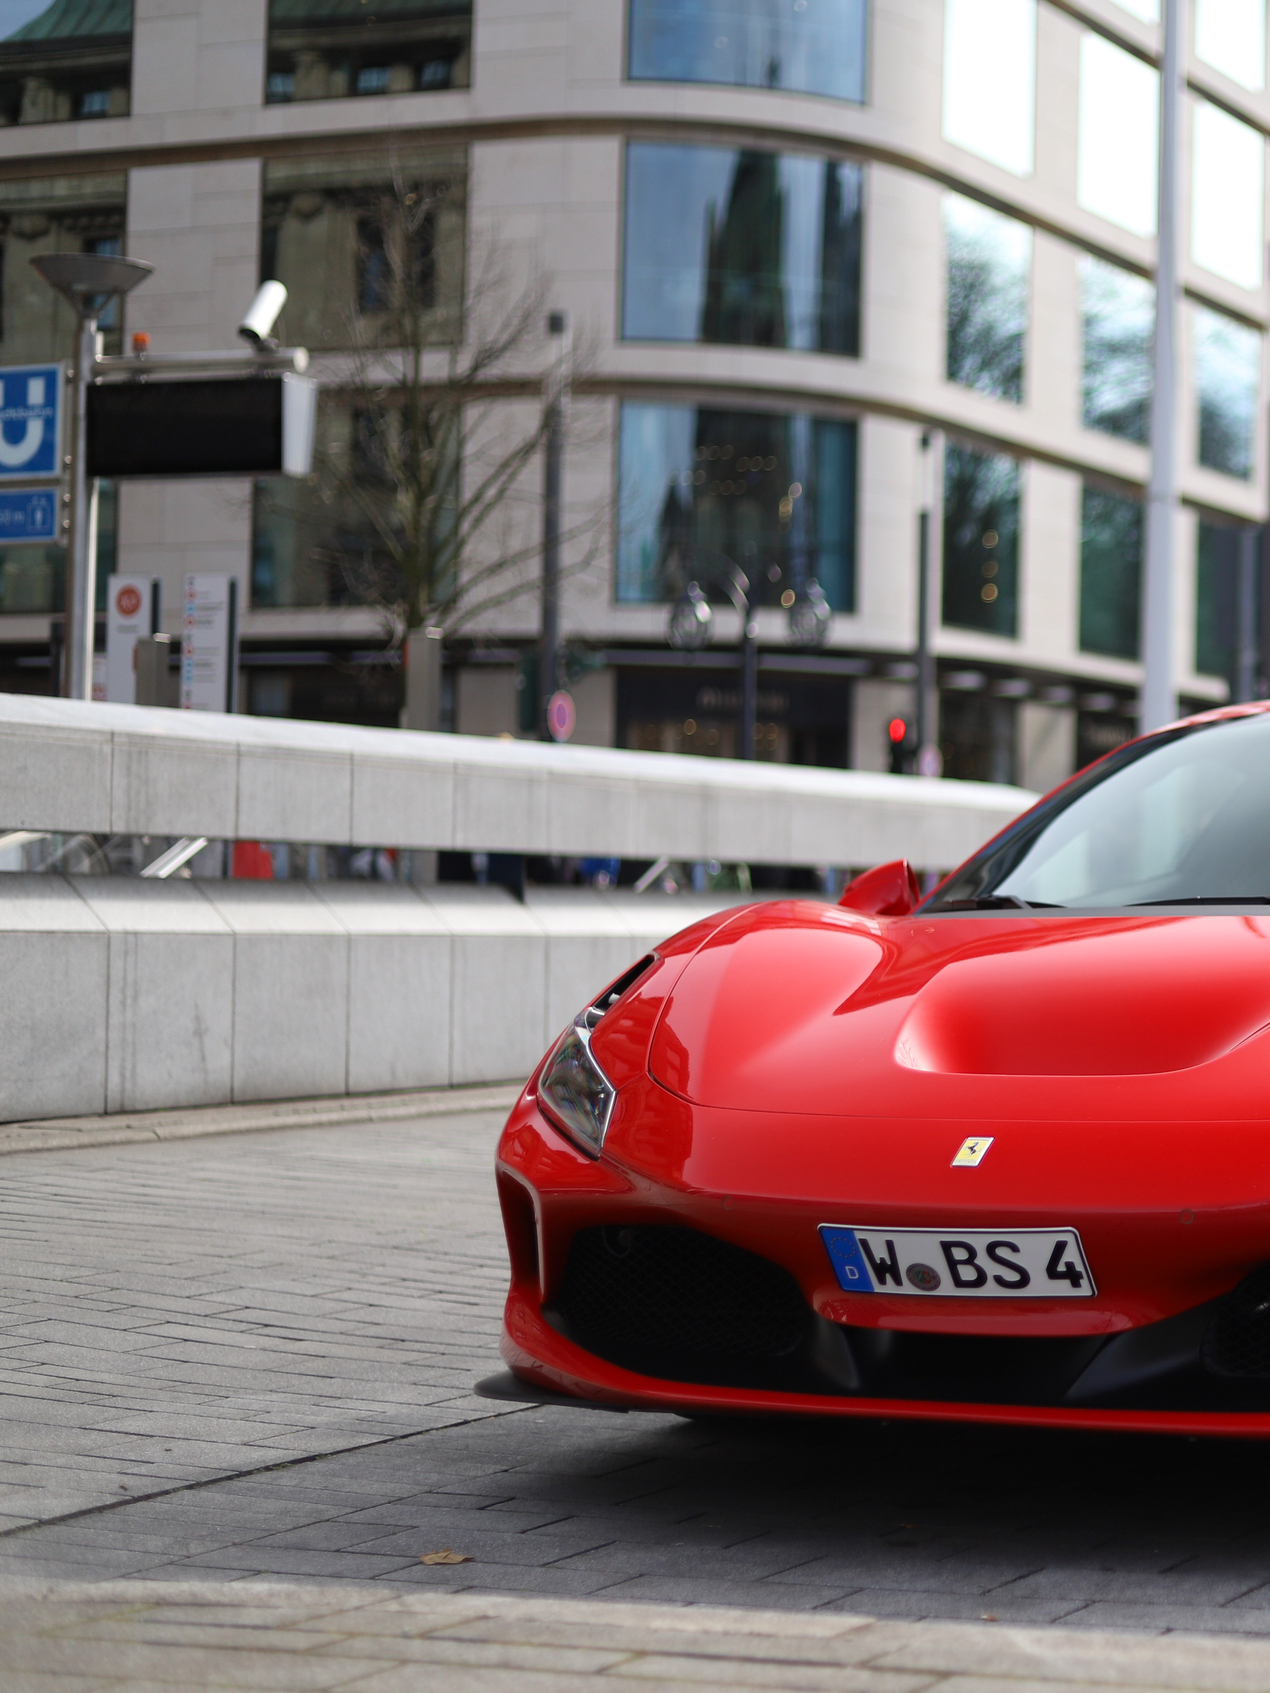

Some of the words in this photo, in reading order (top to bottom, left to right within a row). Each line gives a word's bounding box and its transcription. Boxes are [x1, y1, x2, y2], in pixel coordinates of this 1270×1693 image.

[845, 1266, 859, 1279] D
[858, 1237, 903, 1286] W
[940, 1240, 1030, 1289] BS
[1046, 1240, 1084, 1288] 4
